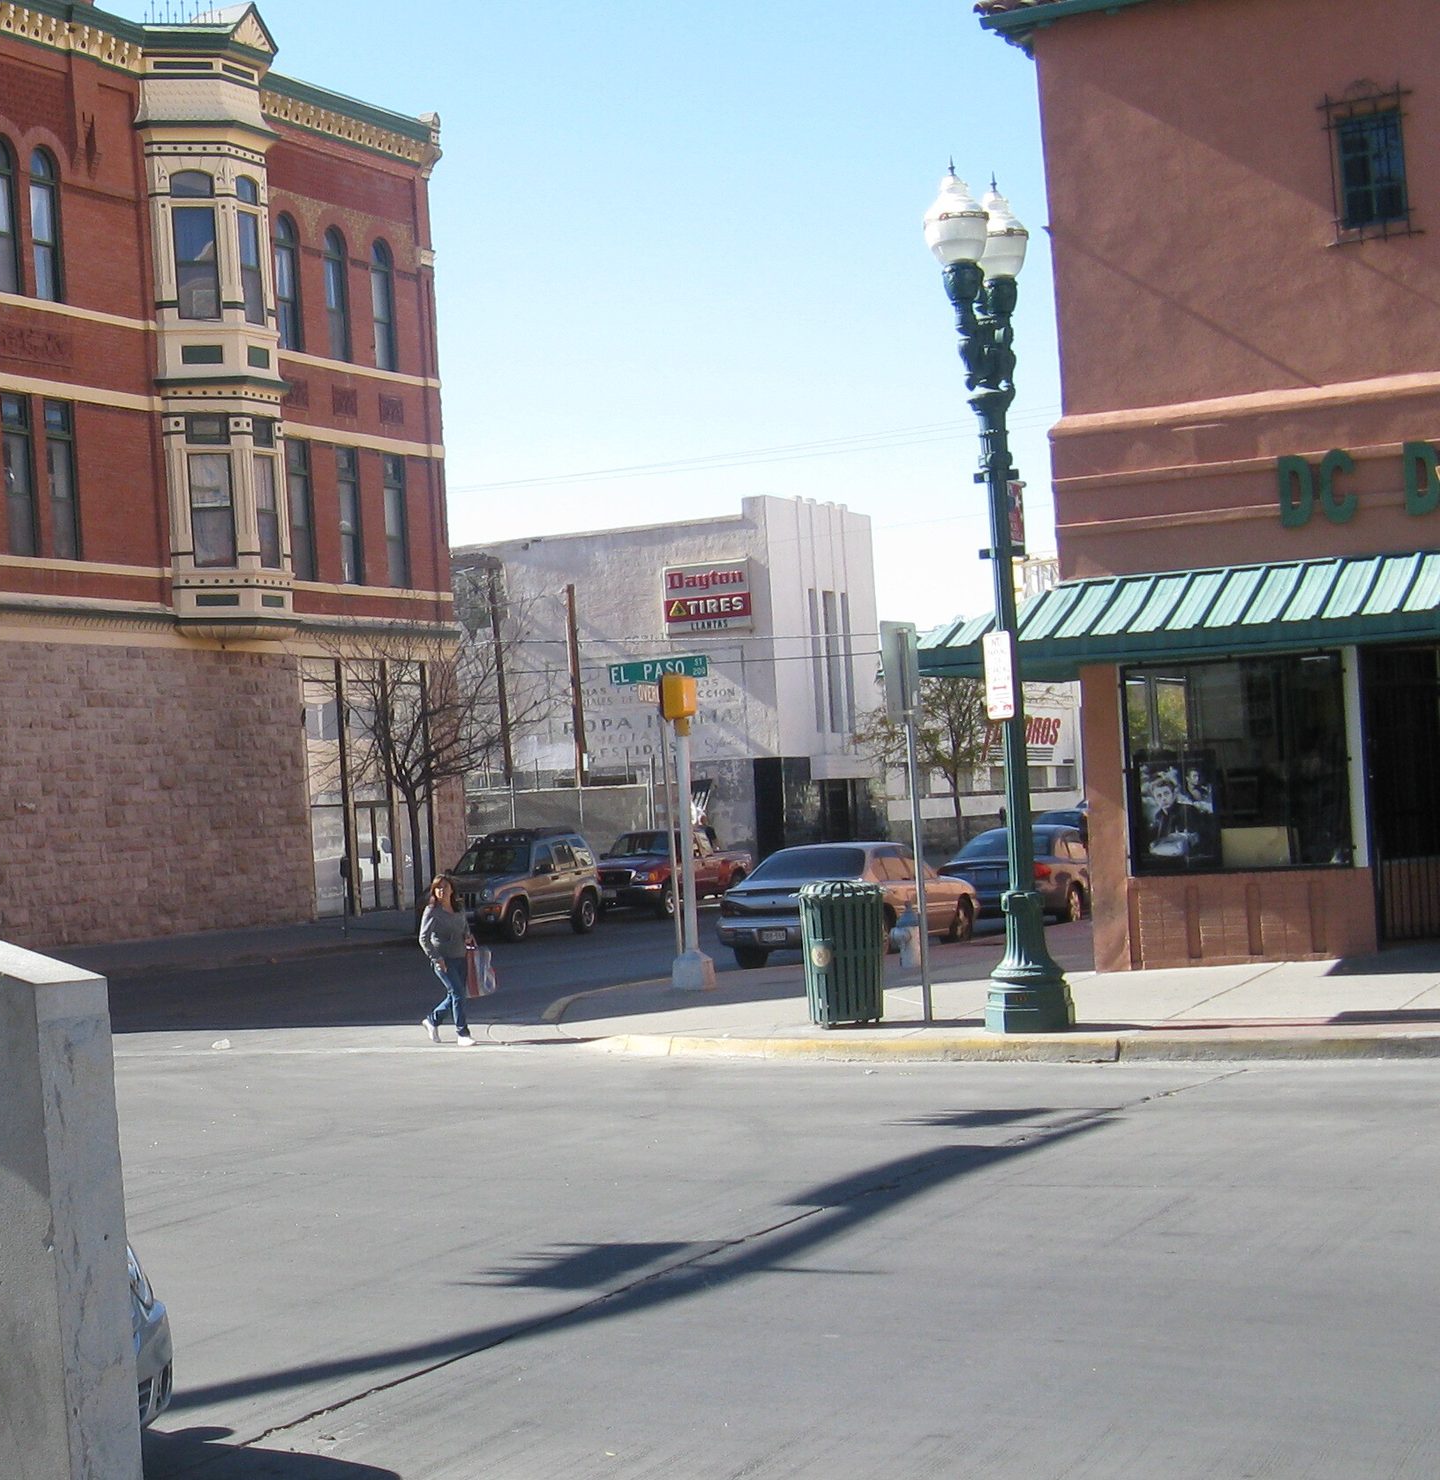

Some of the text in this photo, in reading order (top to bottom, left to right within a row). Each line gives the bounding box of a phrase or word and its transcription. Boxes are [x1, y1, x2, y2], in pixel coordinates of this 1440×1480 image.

[1277, 448, 1358, 528] DC
[667, 570, 744, 590] Dayton
[687, 596, 744, 616] TIRES
[691, 619, 728, 631] LLANTAS
[611, 666, 630, 683] EL
[643, 661, 685, 680] PASO
